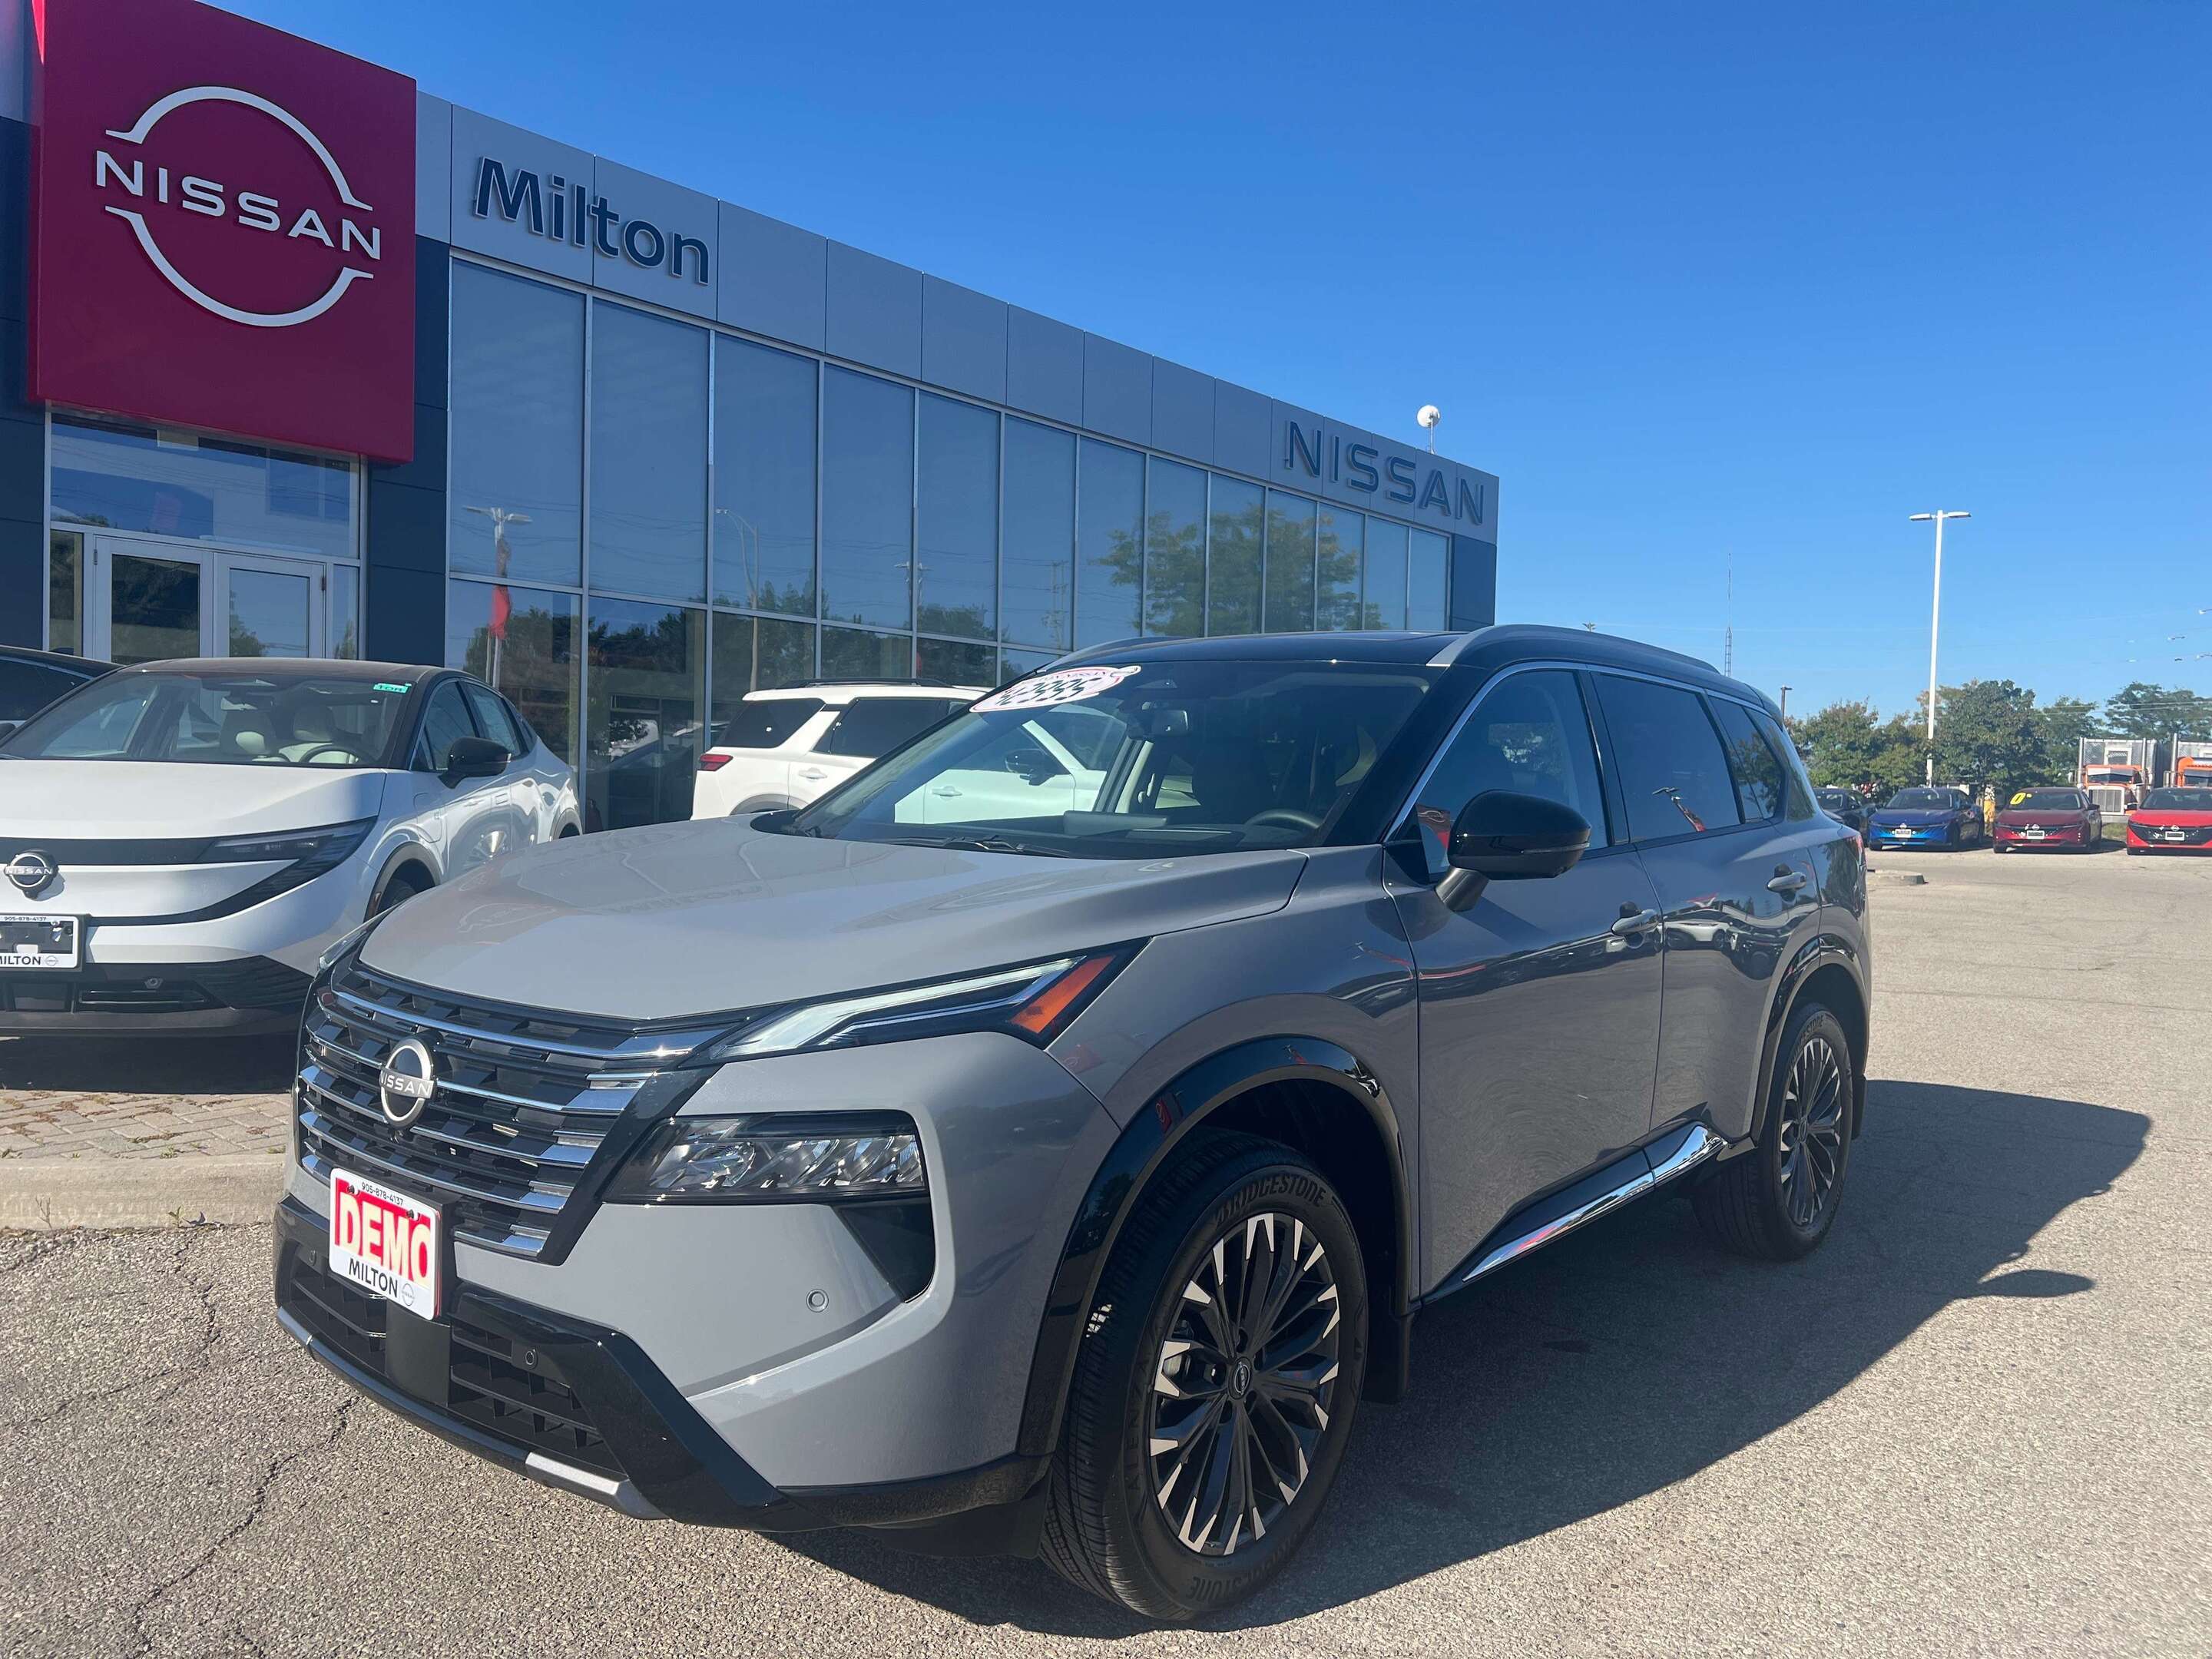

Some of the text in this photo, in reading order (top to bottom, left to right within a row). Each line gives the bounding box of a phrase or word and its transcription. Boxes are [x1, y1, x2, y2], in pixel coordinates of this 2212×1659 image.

[97, 150, 380, 260] NISSAN
[474, 156, 710, 286] Milton
[1285, 421, 1484, 525] NISSAN
[0, 955, 41, 965] ILTON
[380, 1068, 432, 1096] NISSAN
[361, 1181, 404, 1206] 905-878-4137
[1216, 1171, 1326, 1227] BRIDGESTONE
[338, 1190, 432, 1290] DEMO
[348, 1257, 398, 1298] MILTON
